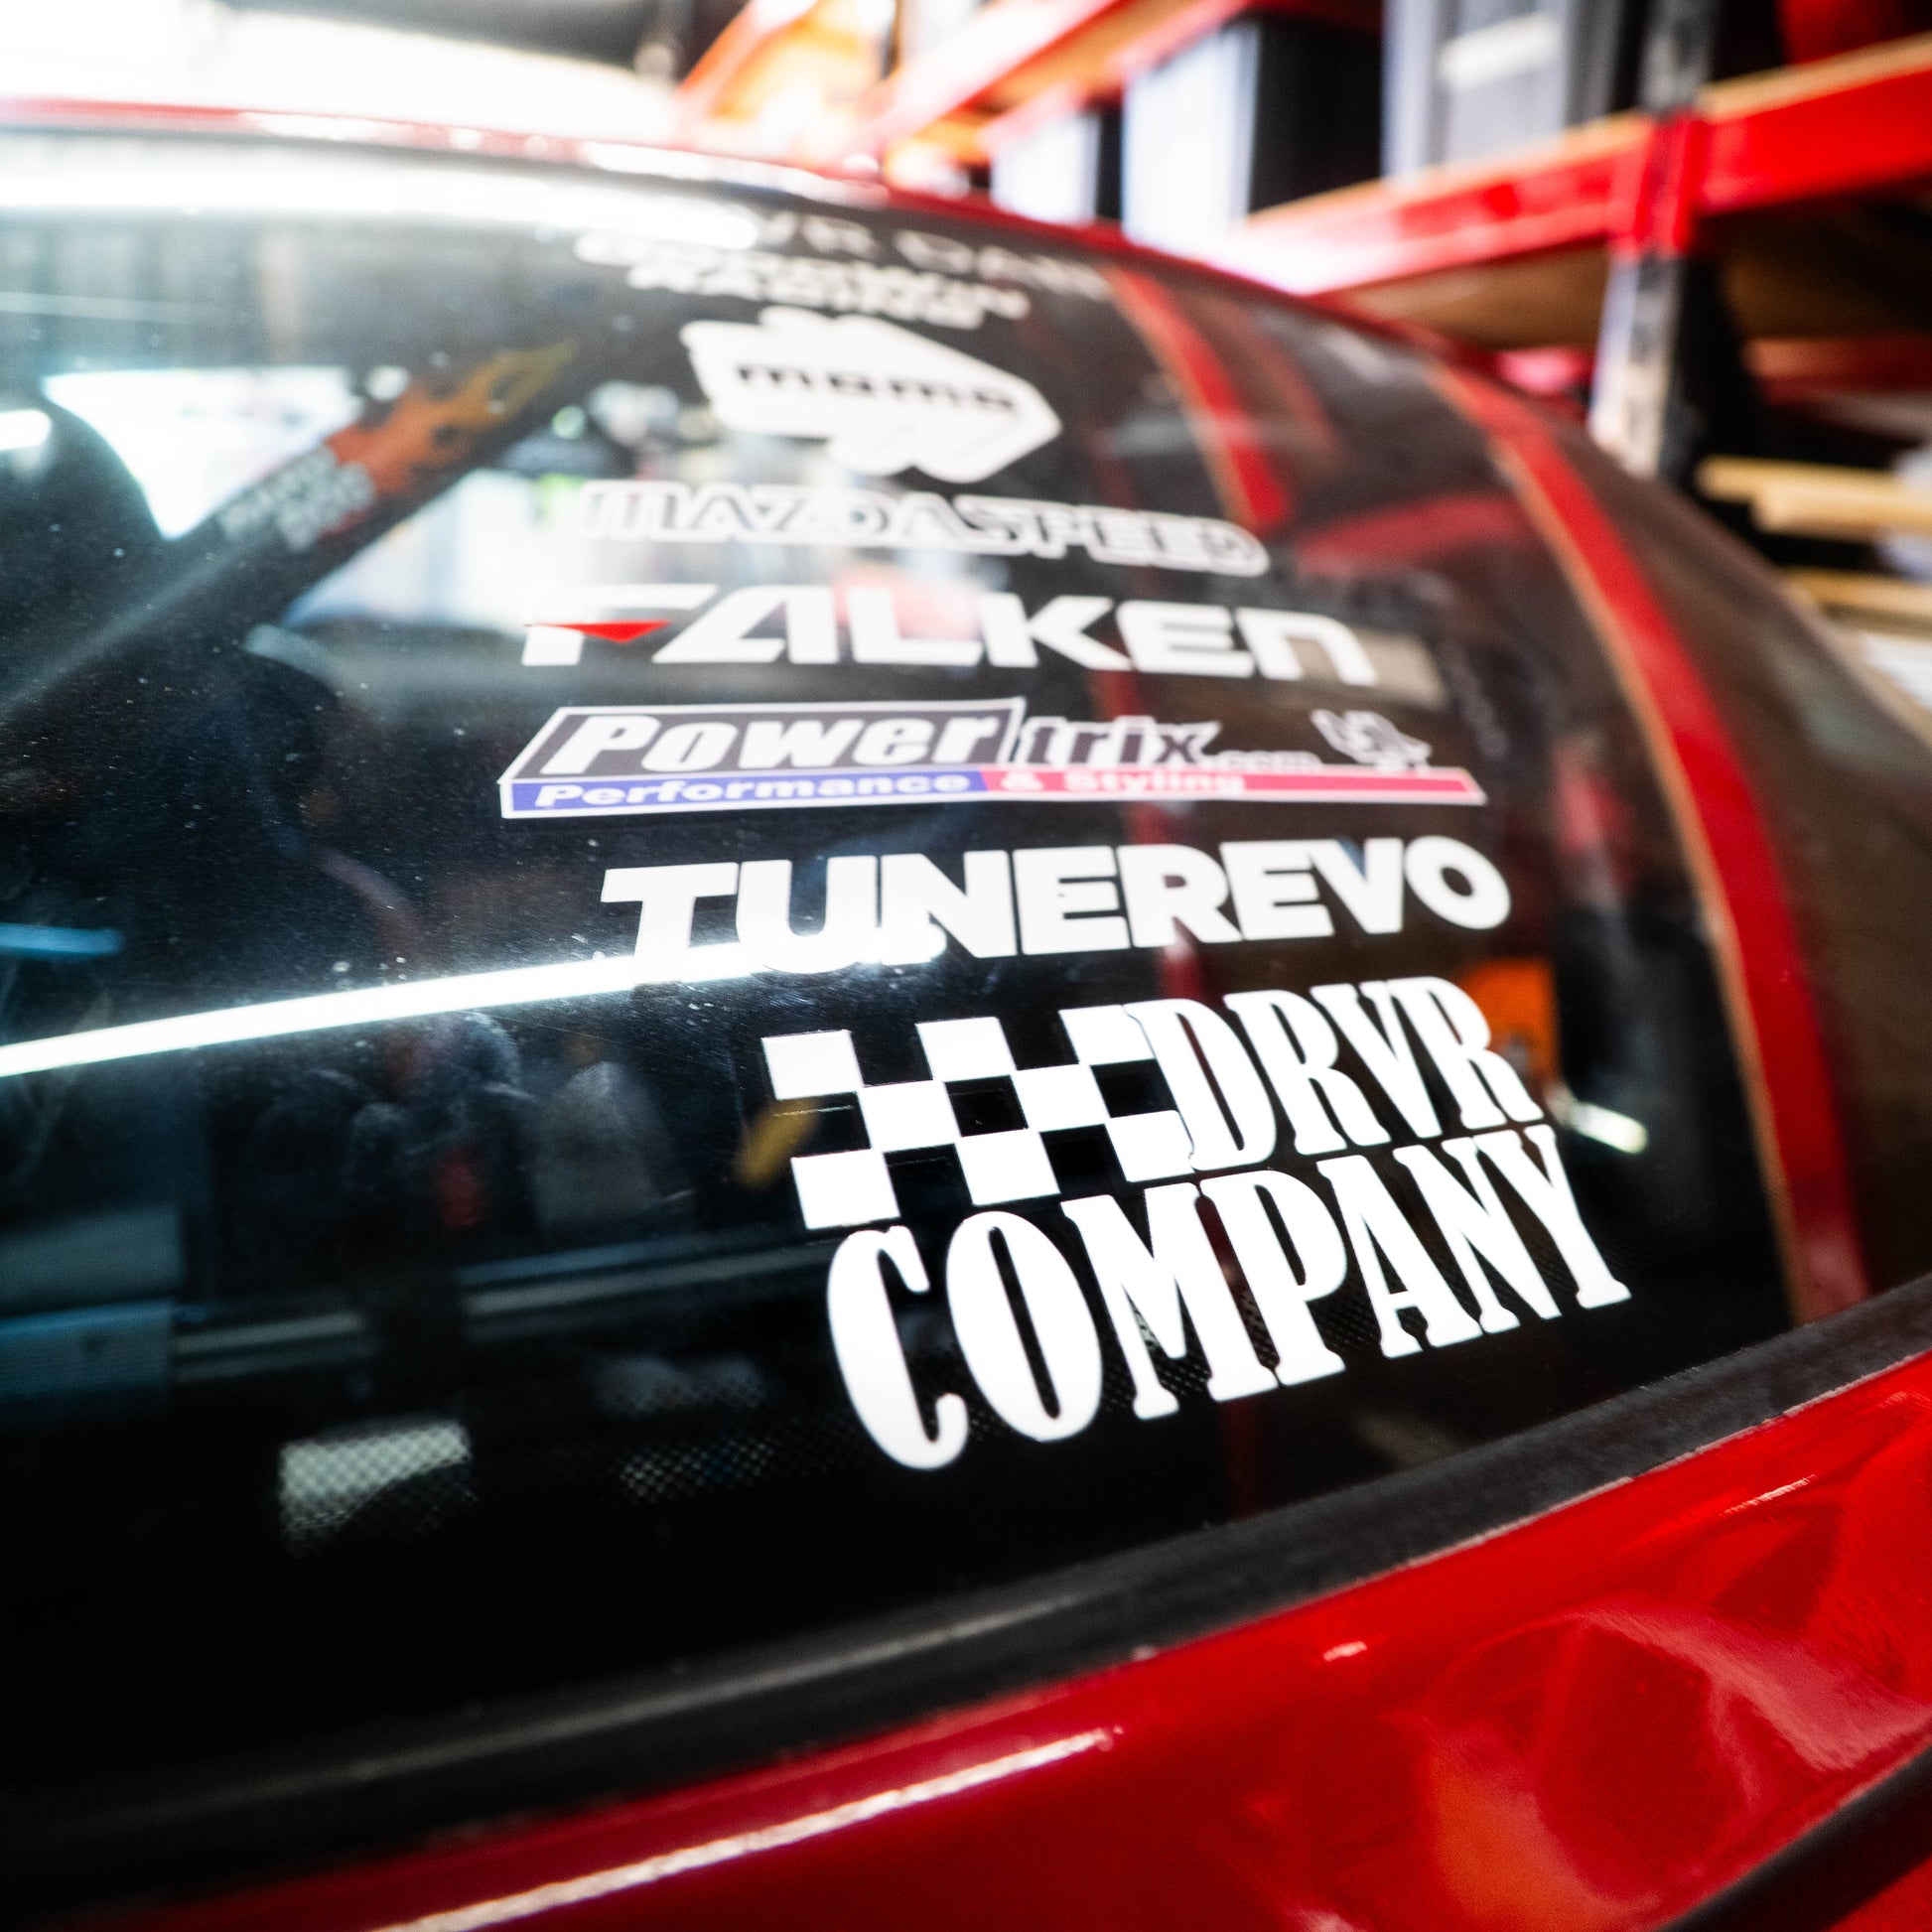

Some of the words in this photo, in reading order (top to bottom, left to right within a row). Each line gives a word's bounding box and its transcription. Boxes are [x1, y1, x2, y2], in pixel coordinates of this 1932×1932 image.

[534, 774, 971, 807] Performance
[1001, 770, 1044, 792] &
[1063, 770, 1247, 795] Styling
[600, 835, 1511, 974] TUNEREVO
[1122, 976, 1544, 1172] DRVR
[826, 1123, 1631, 1470] COMPANY
